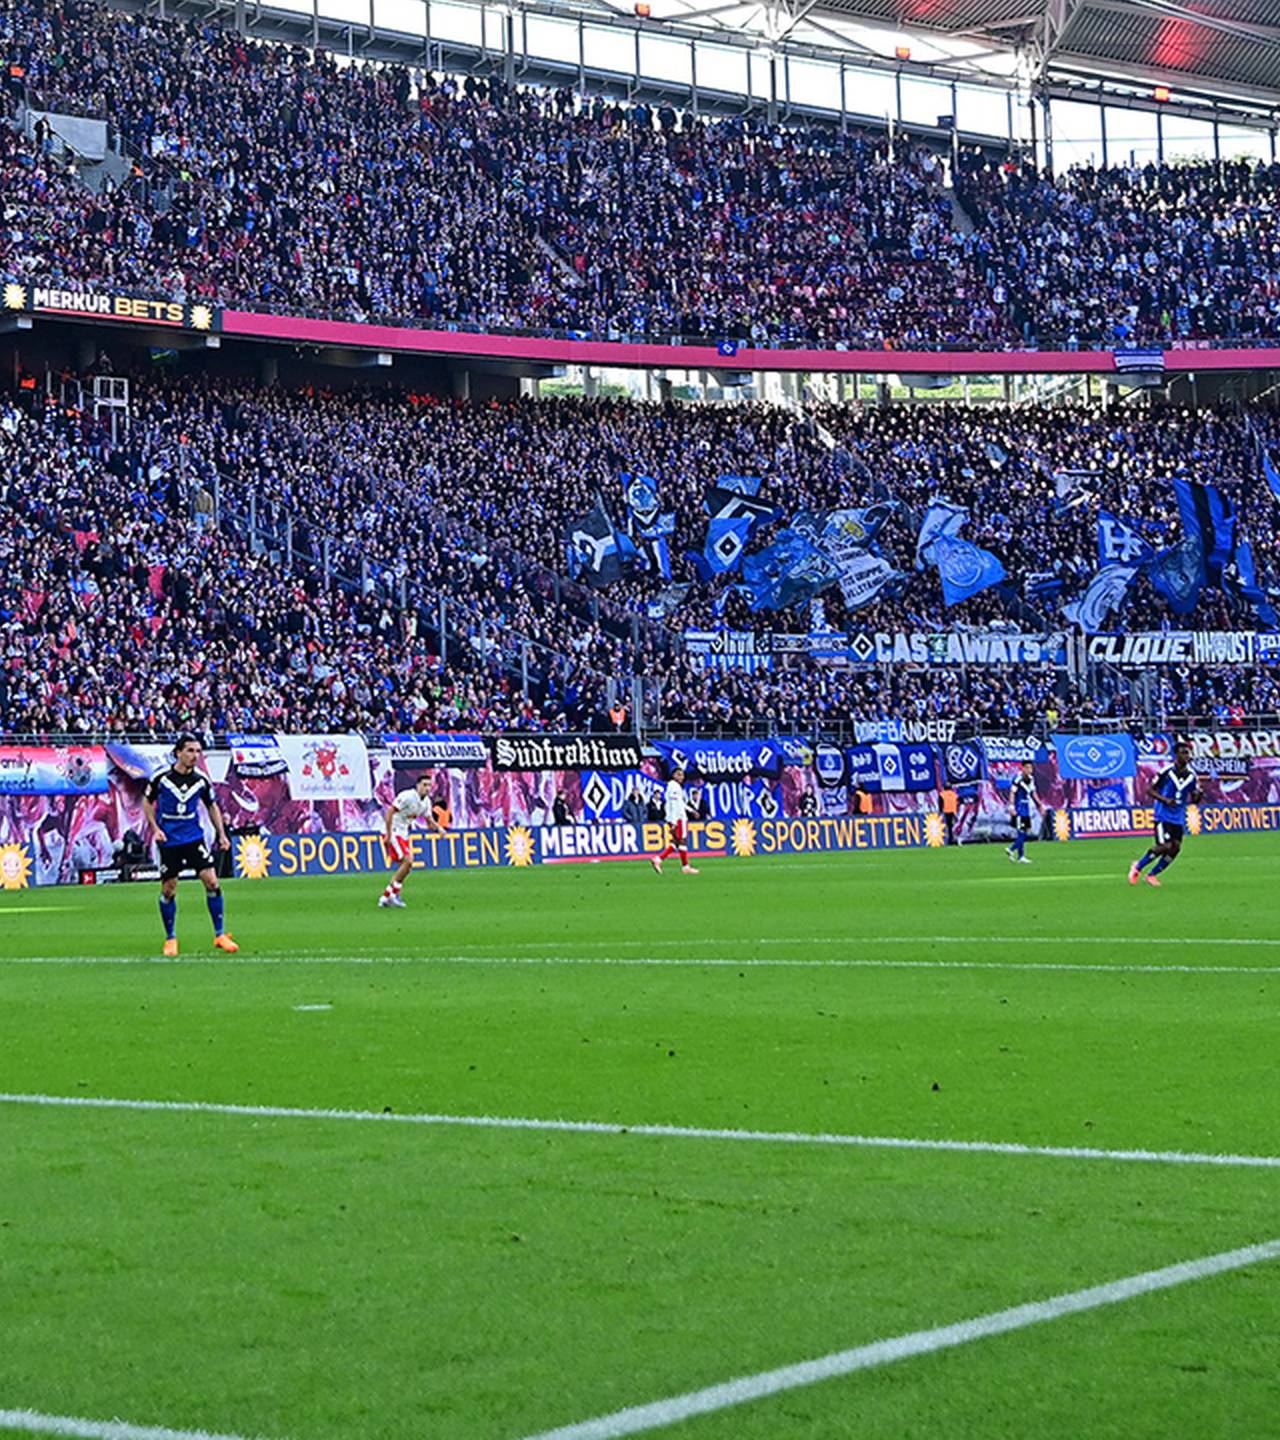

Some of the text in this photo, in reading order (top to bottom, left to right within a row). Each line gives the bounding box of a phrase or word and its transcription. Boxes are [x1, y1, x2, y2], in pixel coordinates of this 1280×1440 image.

[33, 288, 183, 321] MERKUR BETS
[695, 750, 753, 774] Lübeck
[761, 817, 920, 850] SPORTWETTEN
[1074, 809, 1130, 832] MERKUR
[541, 824, 638, 856] MERKUR
